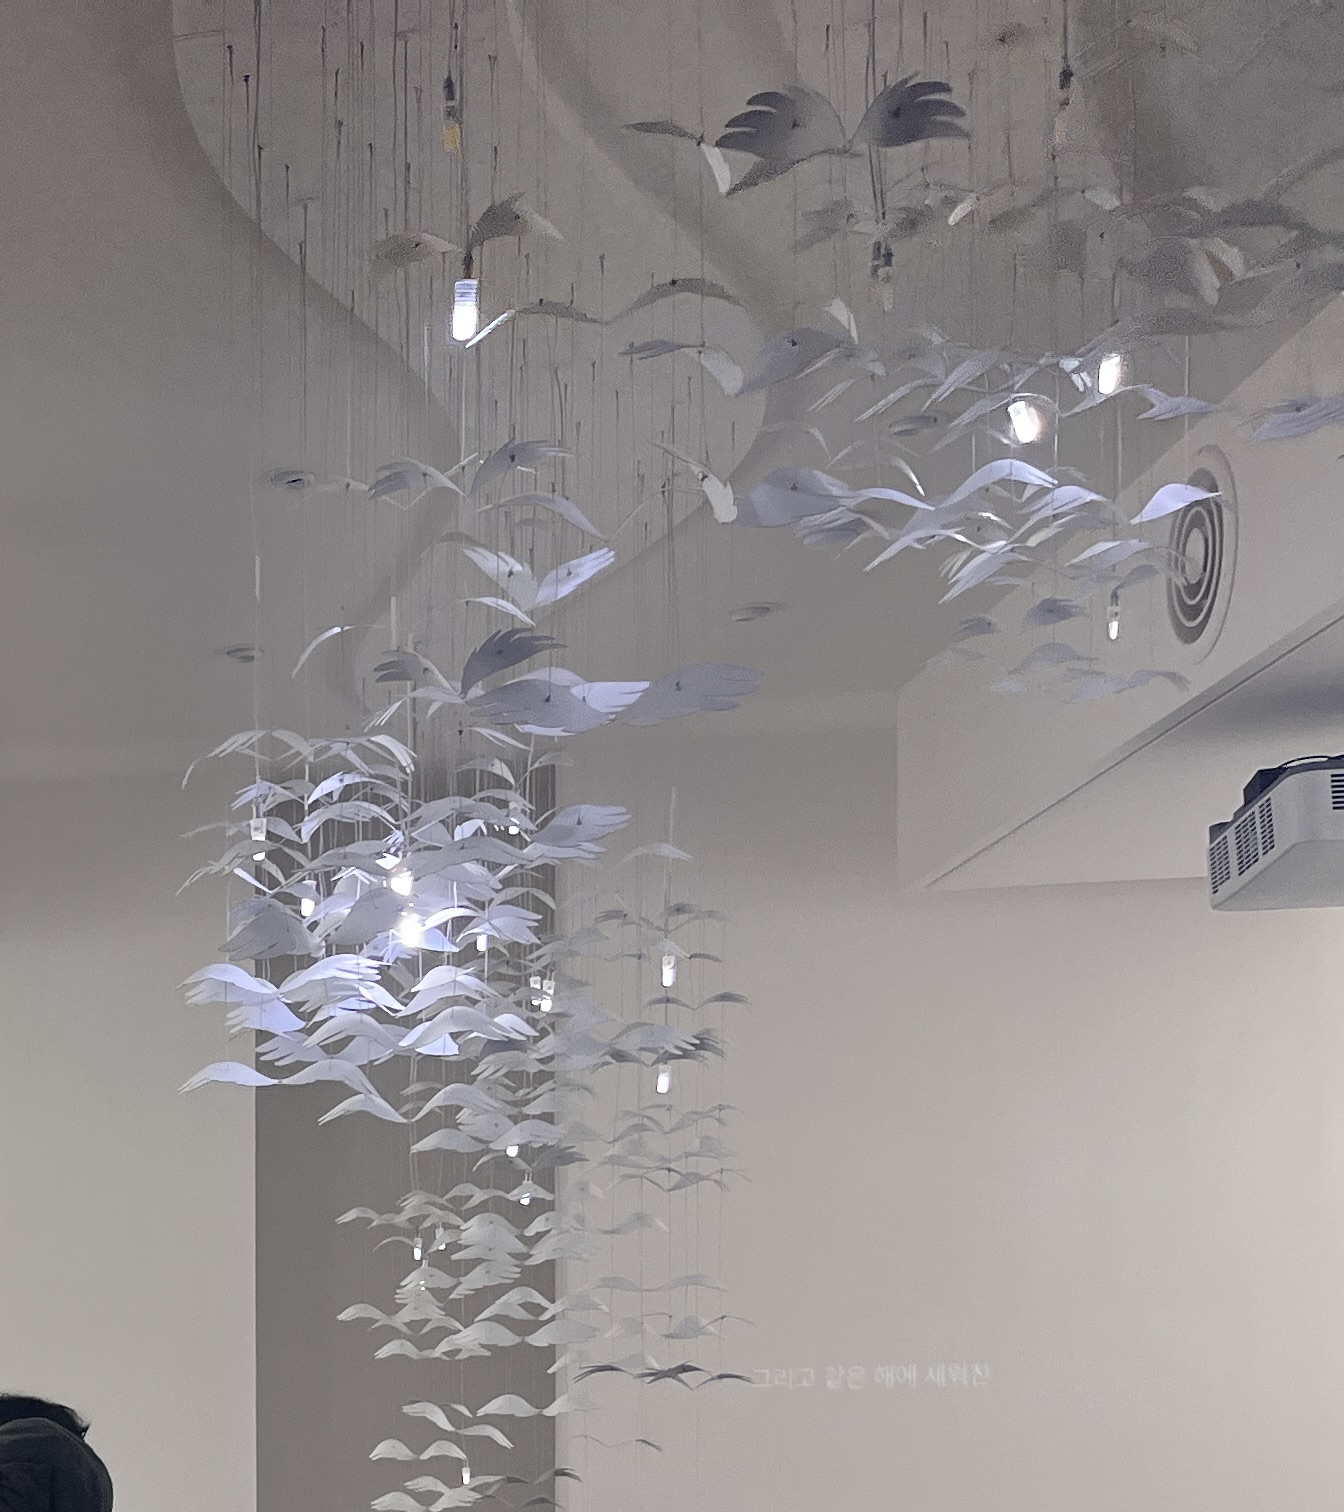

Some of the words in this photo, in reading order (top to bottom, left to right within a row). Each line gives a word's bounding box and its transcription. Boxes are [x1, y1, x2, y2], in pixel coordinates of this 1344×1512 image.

[750, 1367, 815, 1391] 그리고
[825, 1365, 865, 1390] 같은
[874, 1363, 917, 1389] 해에
